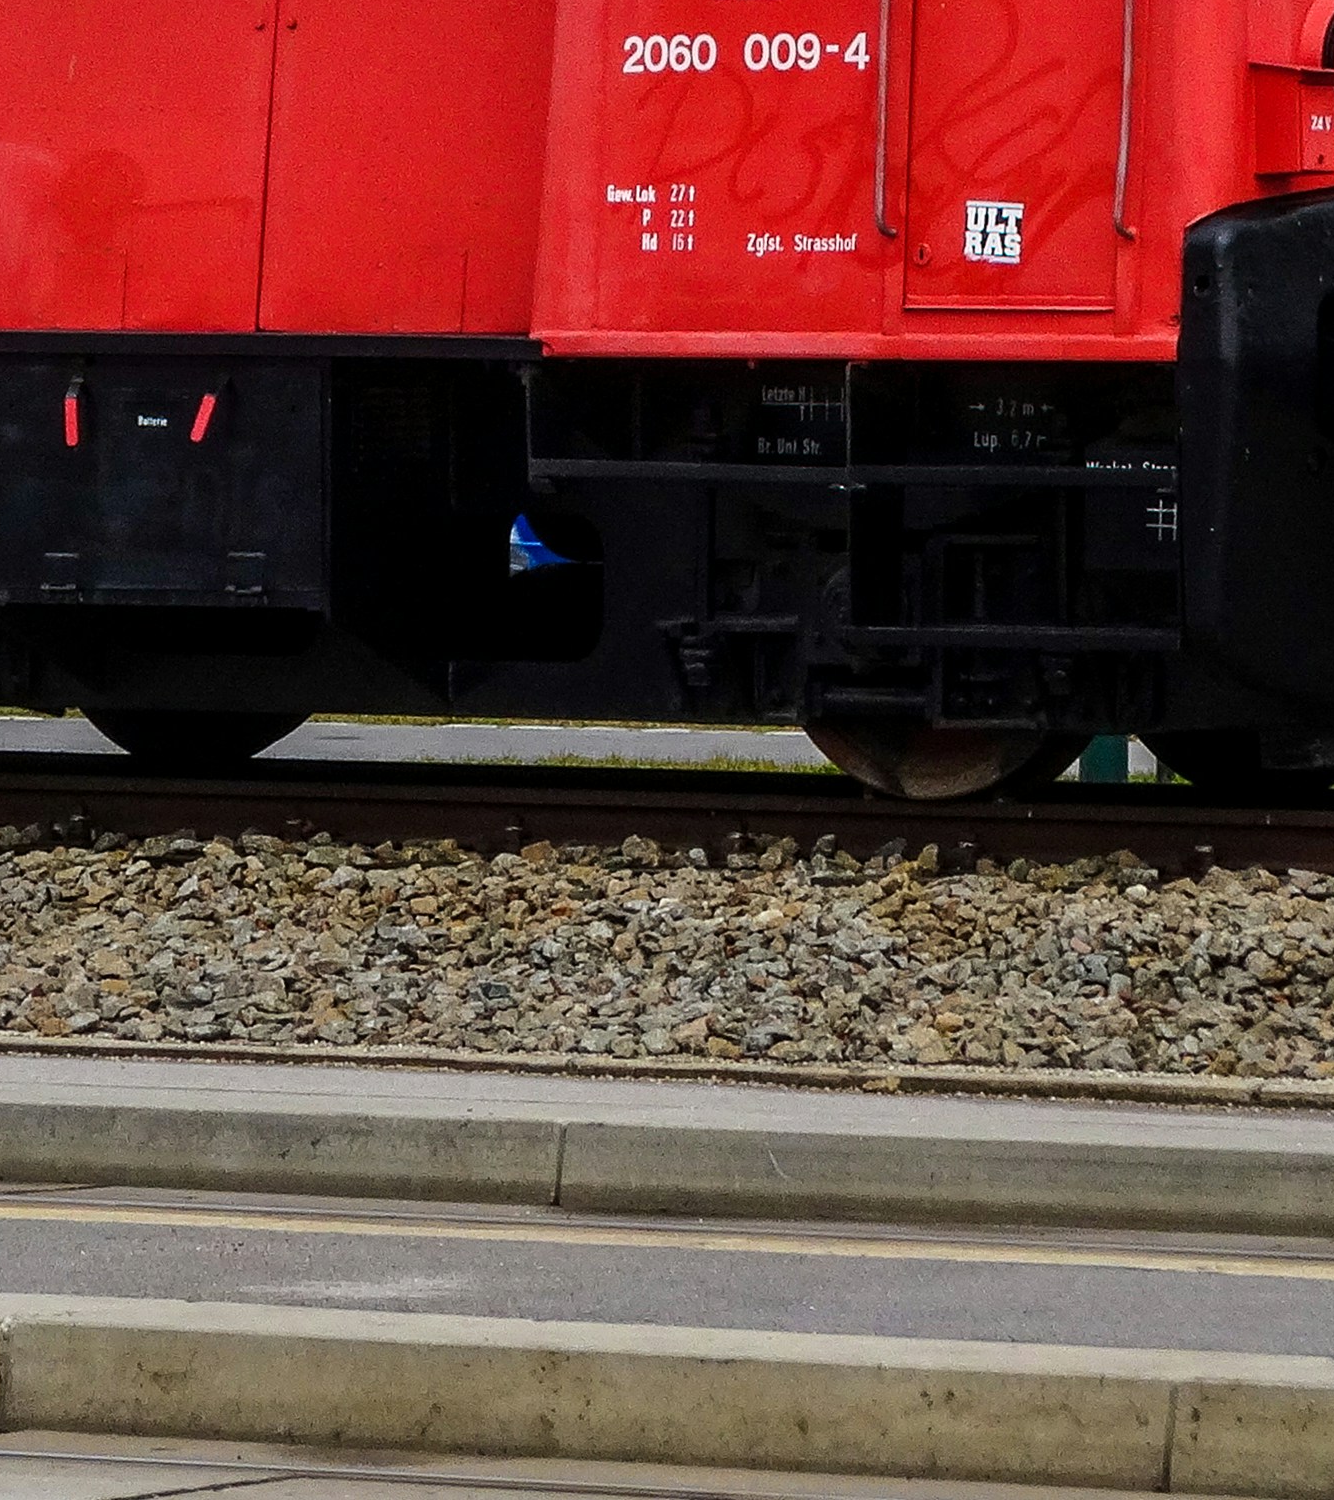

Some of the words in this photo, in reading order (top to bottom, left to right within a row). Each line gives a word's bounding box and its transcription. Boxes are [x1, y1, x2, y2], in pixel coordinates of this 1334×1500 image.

[622, 33, 717, 74] 2060
[743, 32, 871, 72] 009-4
[606, 184, 634, 203] Gew.
[635, 184, 656, 203] Lok
[670, 183, 686, 202] 27
[688, 185, 695, 202] t
[642, 208, 652, 227] P
[670, 209, 685, 228] 22
[688, 209, 695, 227] t
[966, 206, 1023, 234] ULT
[641, 232, 658, 251] Hd
[671, 233, 685, 251] 16
[687, 234, 694, 251] t
[793, 233, 858, 252] Strasshof
[964, 231, 1022, 257] RAS
